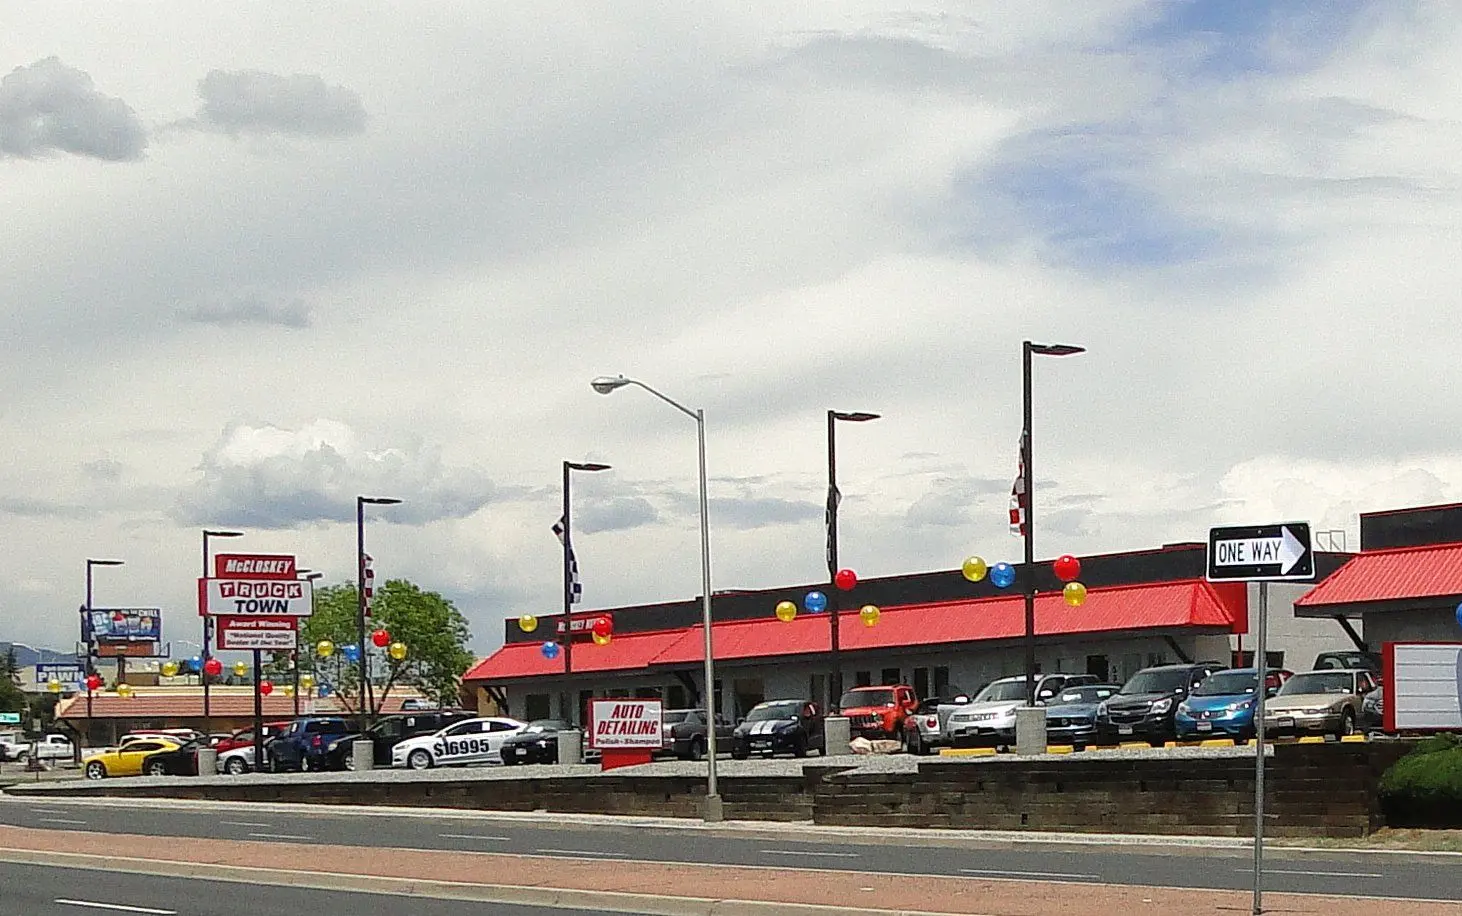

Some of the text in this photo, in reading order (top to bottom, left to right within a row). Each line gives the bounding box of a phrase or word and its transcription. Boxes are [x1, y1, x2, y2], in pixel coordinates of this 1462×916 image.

[1218, 540, 1282, 563] ONE WAY
[225, 559, 293, 574] McCLOSKEY
[220, 583, 302, 598] TRUCK
[234, 599, 289, 613] TOWN
[228, 620, 291, 629] Award Winning
[37, 671, 85, 682] PAWN
[611, 704, 645, 719] AUTO
[596, 720, 659, 735] DETAILING
[433, 739, 490, 757] $16995
